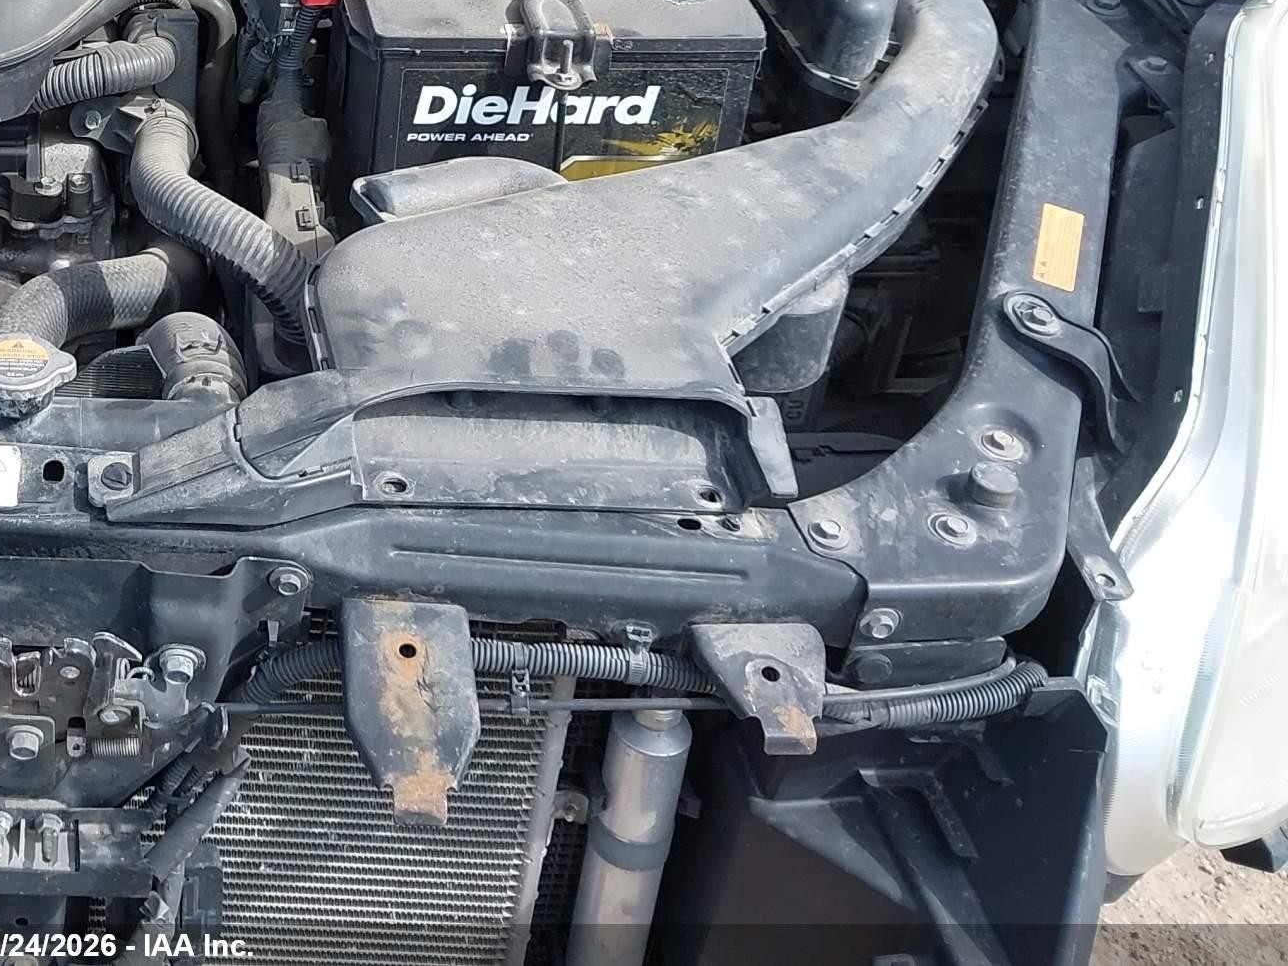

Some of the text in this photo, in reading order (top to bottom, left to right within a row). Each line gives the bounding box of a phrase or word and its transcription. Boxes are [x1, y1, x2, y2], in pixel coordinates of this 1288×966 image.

[413, 84, 661, 125] DieHard
[407, 133, 530, 142] POWER AHEAD
